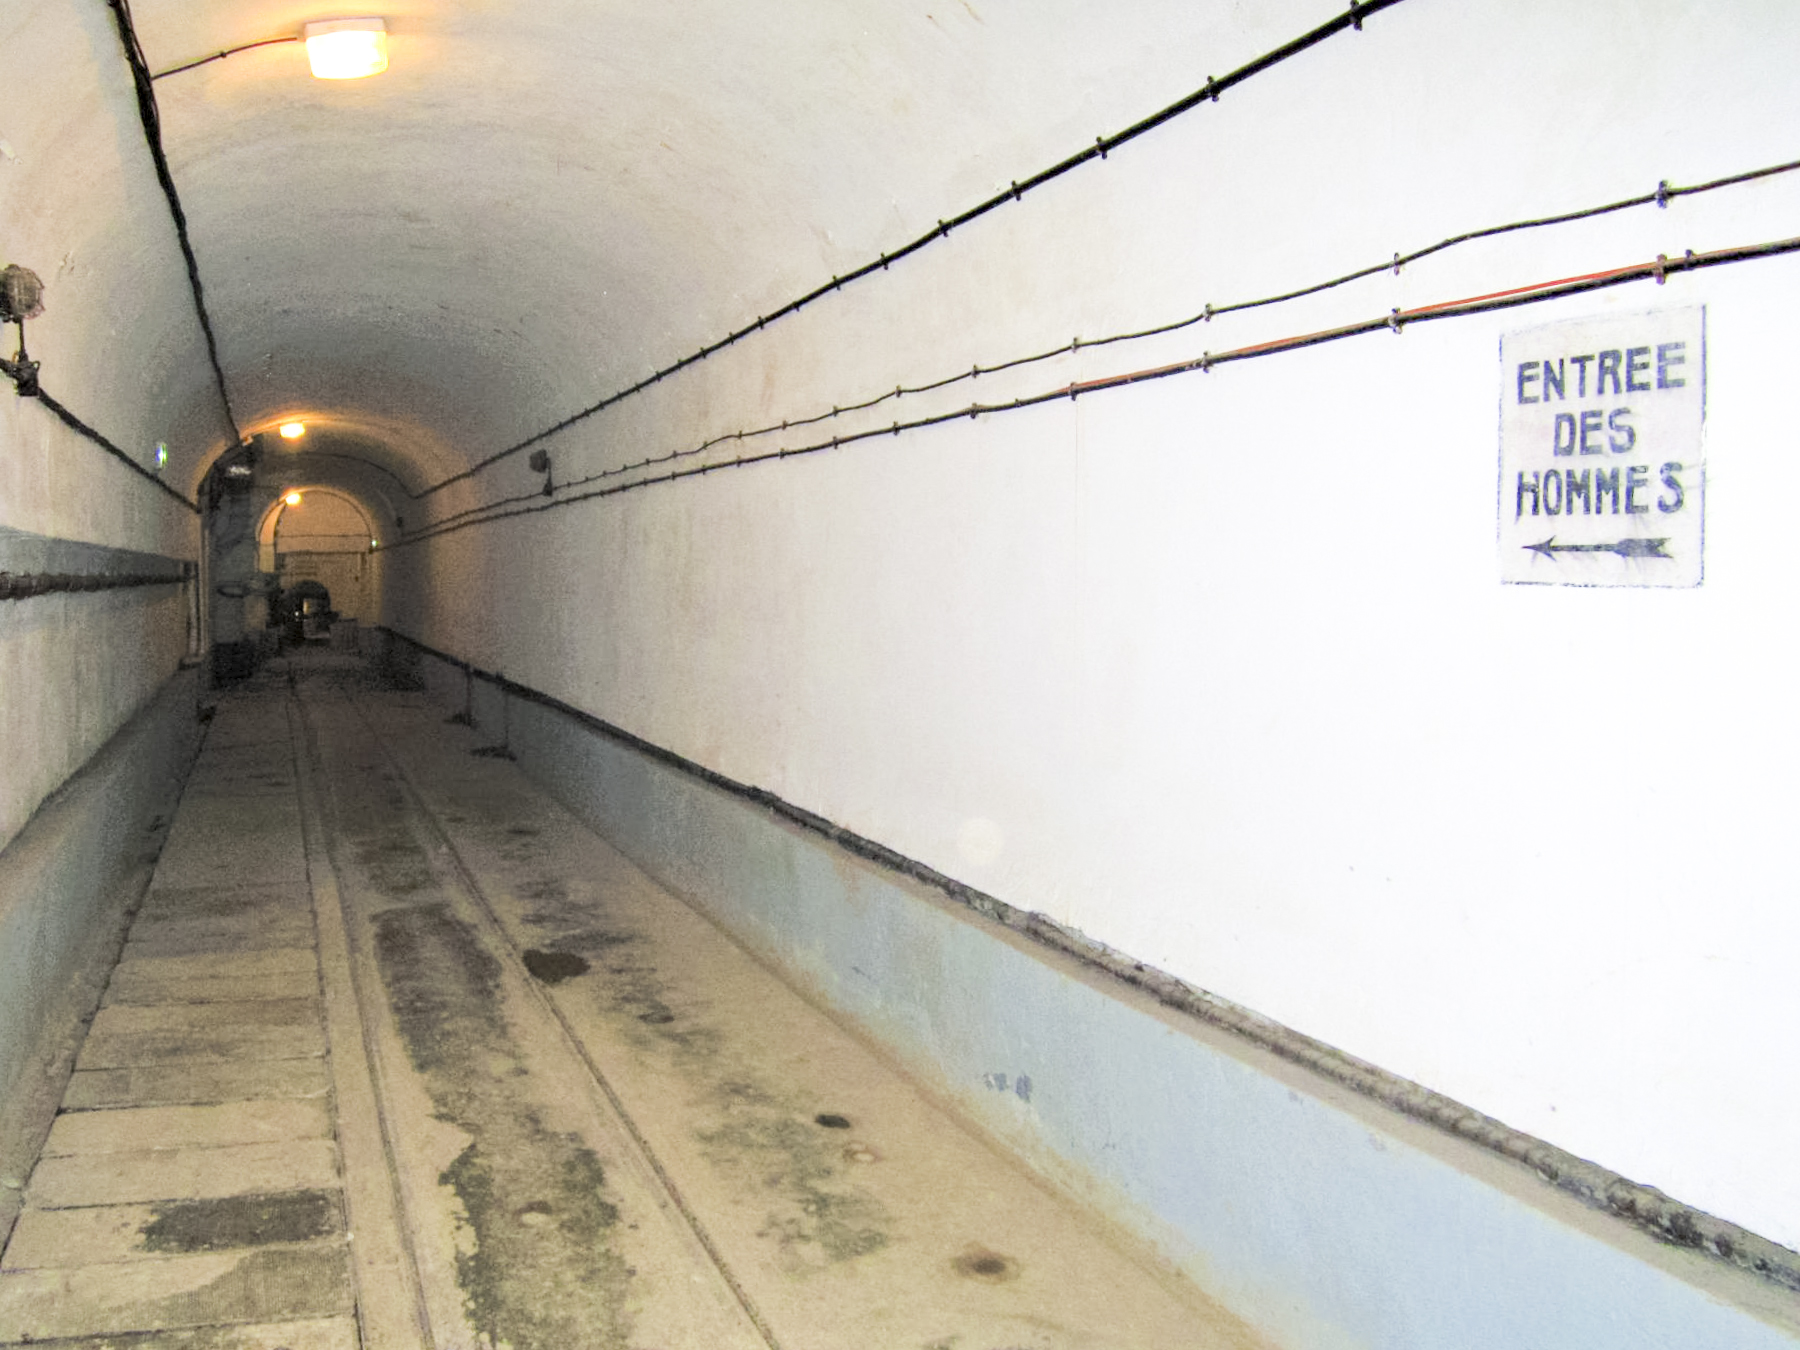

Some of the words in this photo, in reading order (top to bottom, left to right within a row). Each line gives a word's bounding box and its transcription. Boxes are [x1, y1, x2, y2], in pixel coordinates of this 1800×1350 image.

[1517, 342, 1686, 404] ENTREE
[1553, 407, 1636, 456] DES
[1515, 462, 1685, 516] HOMMES
